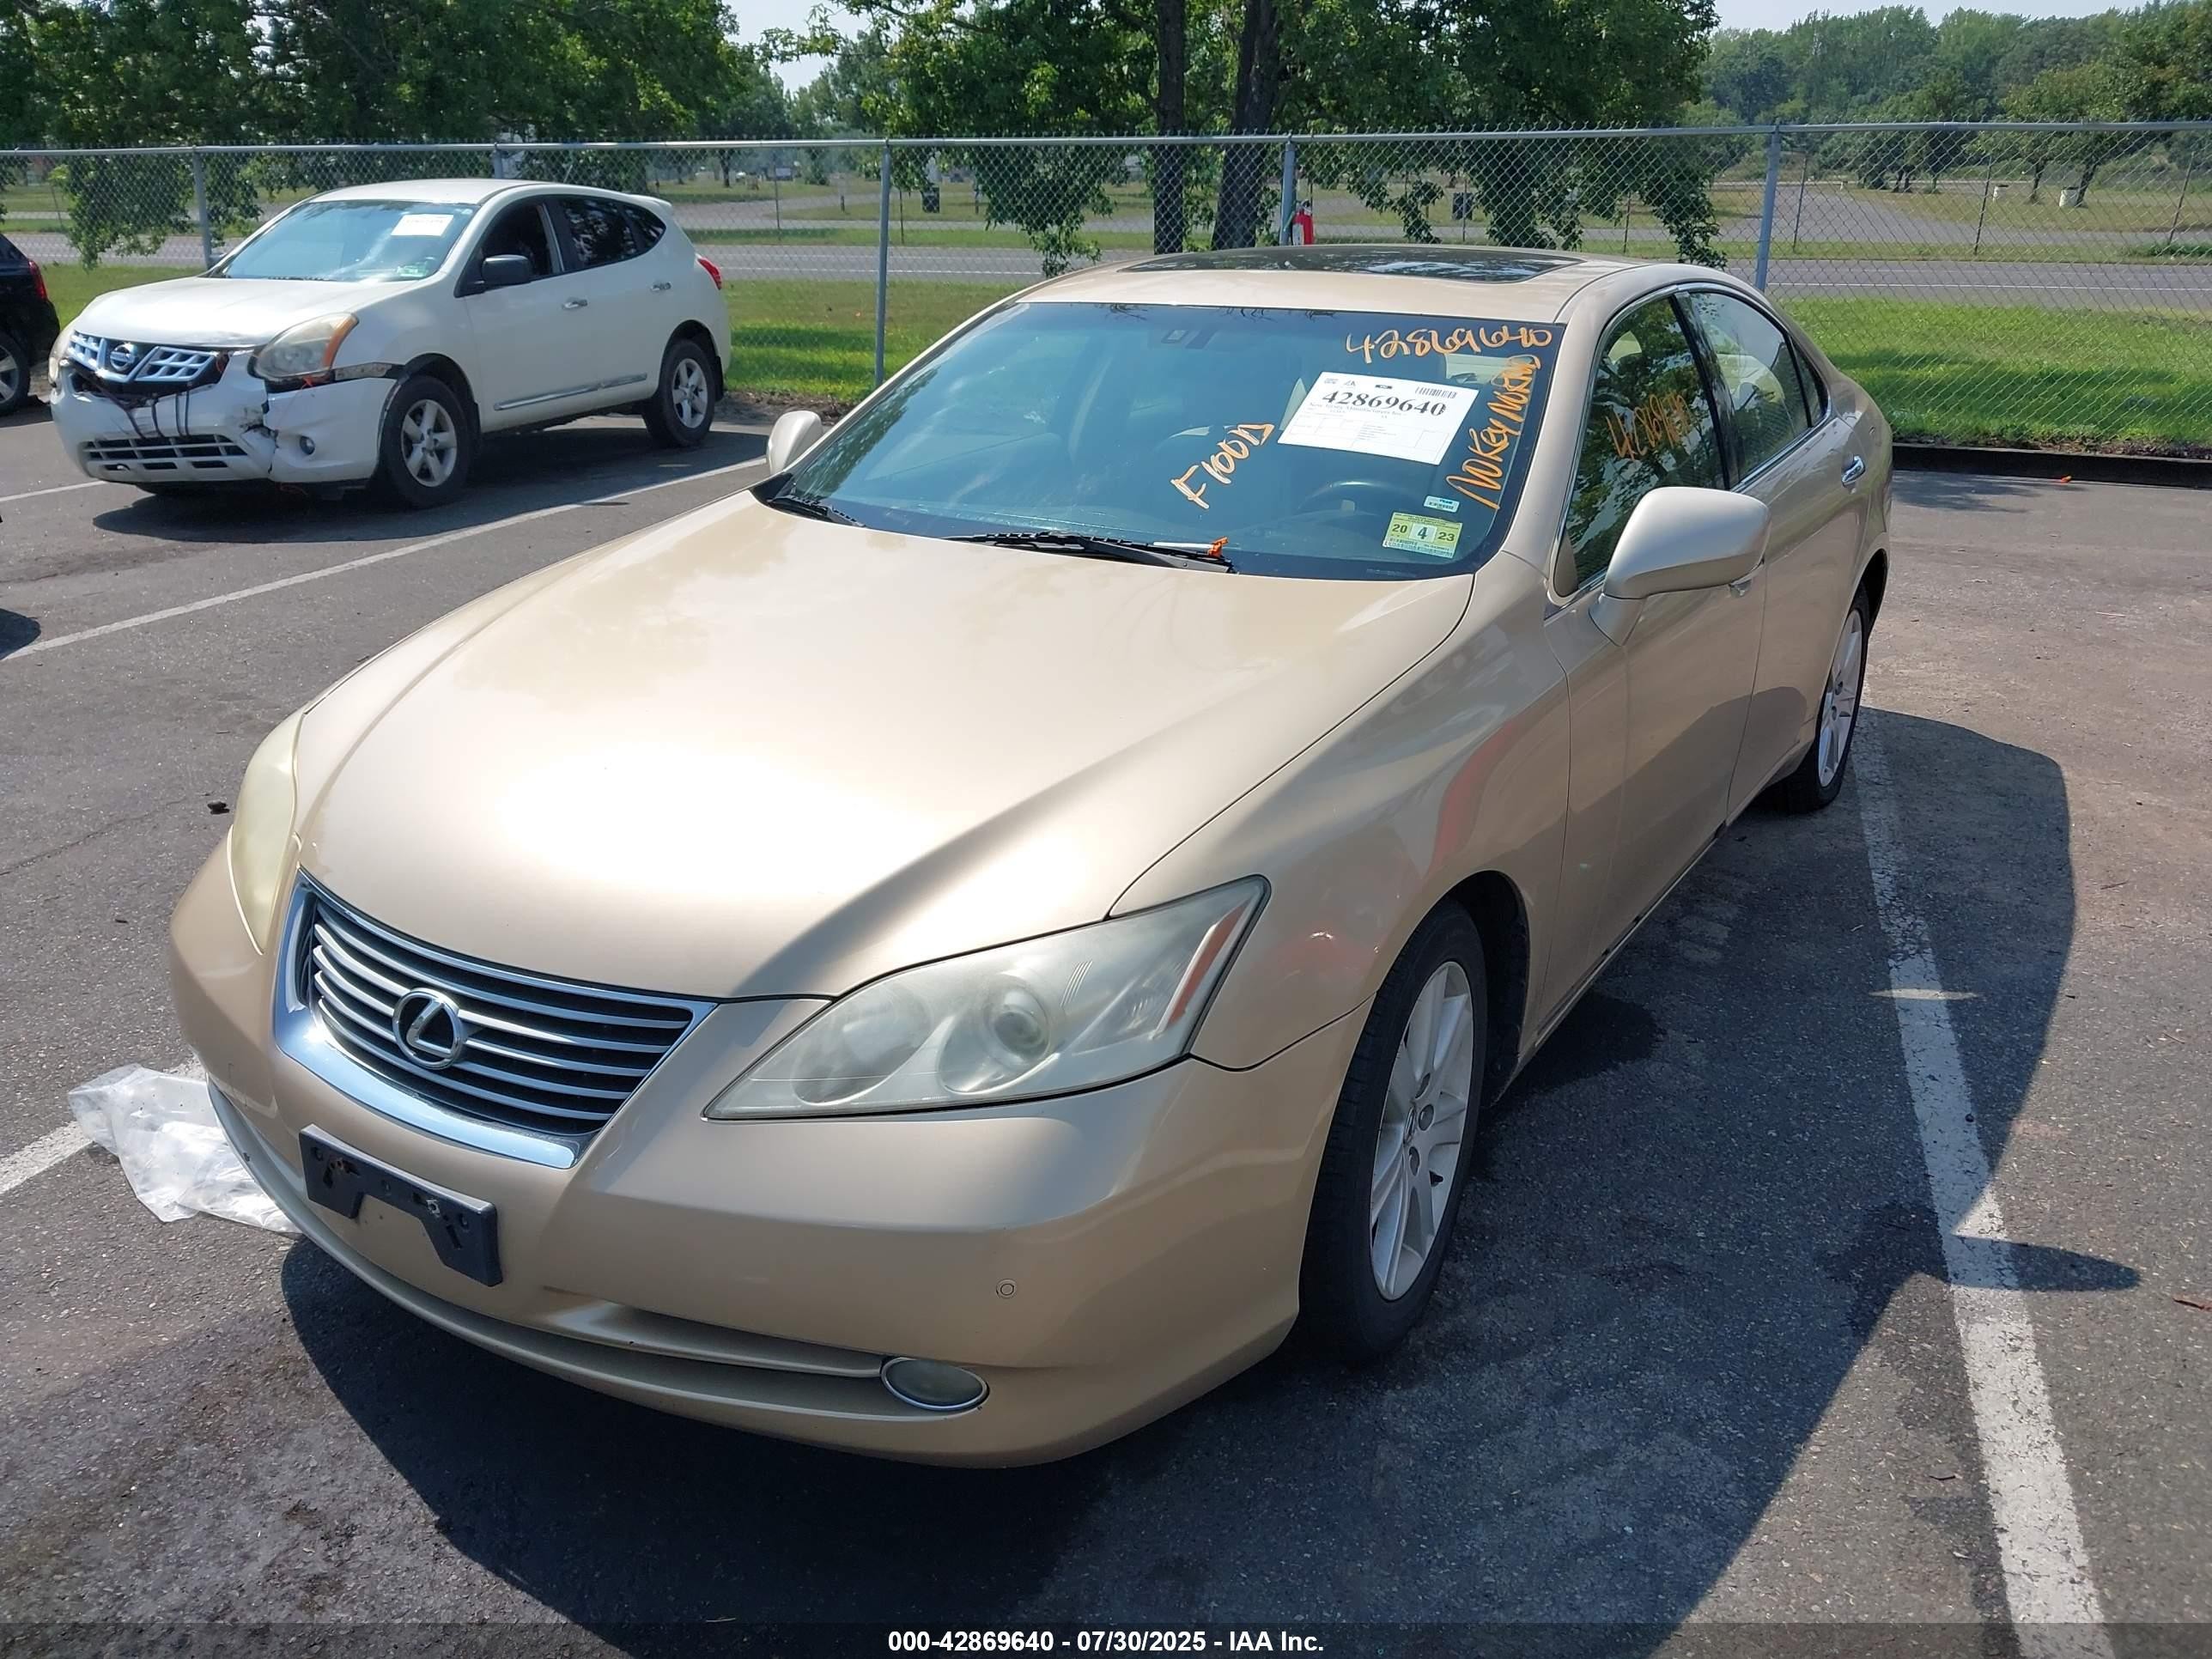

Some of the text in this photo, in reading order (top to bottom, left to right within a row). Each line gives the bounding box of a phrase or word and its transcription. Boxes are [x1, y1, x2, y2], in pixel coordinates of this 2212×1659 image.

[1322, 390, 1447, 416] 42869640
[1392, 523, 1455, 543] 20 4 23
